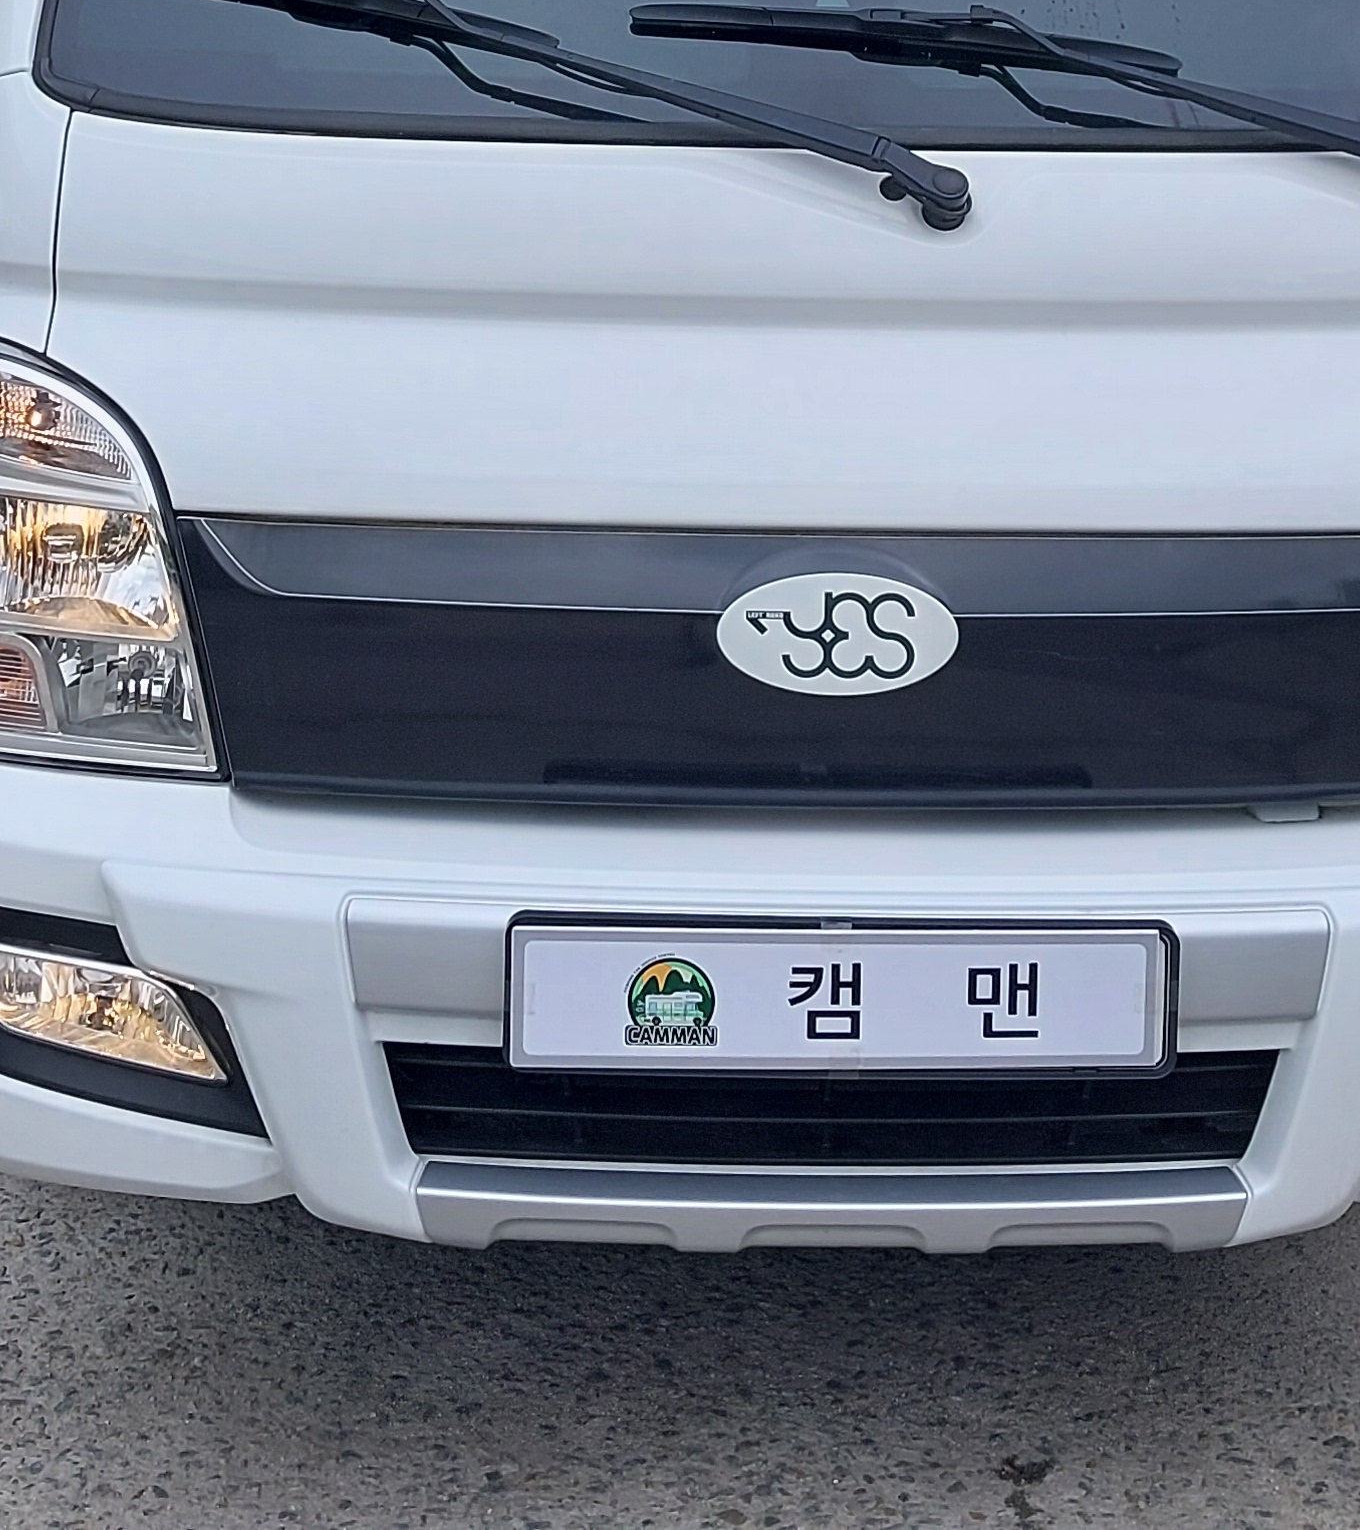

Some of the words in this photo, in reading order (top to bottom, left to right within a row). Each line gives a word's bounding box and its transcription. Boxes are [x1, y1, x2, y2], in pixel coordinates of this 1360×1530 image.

[787, 962, 862, 1040] 캠
[967, 962, 1039, 1039] 맨
[628, 1025, 715, 1045] CAMMAN
